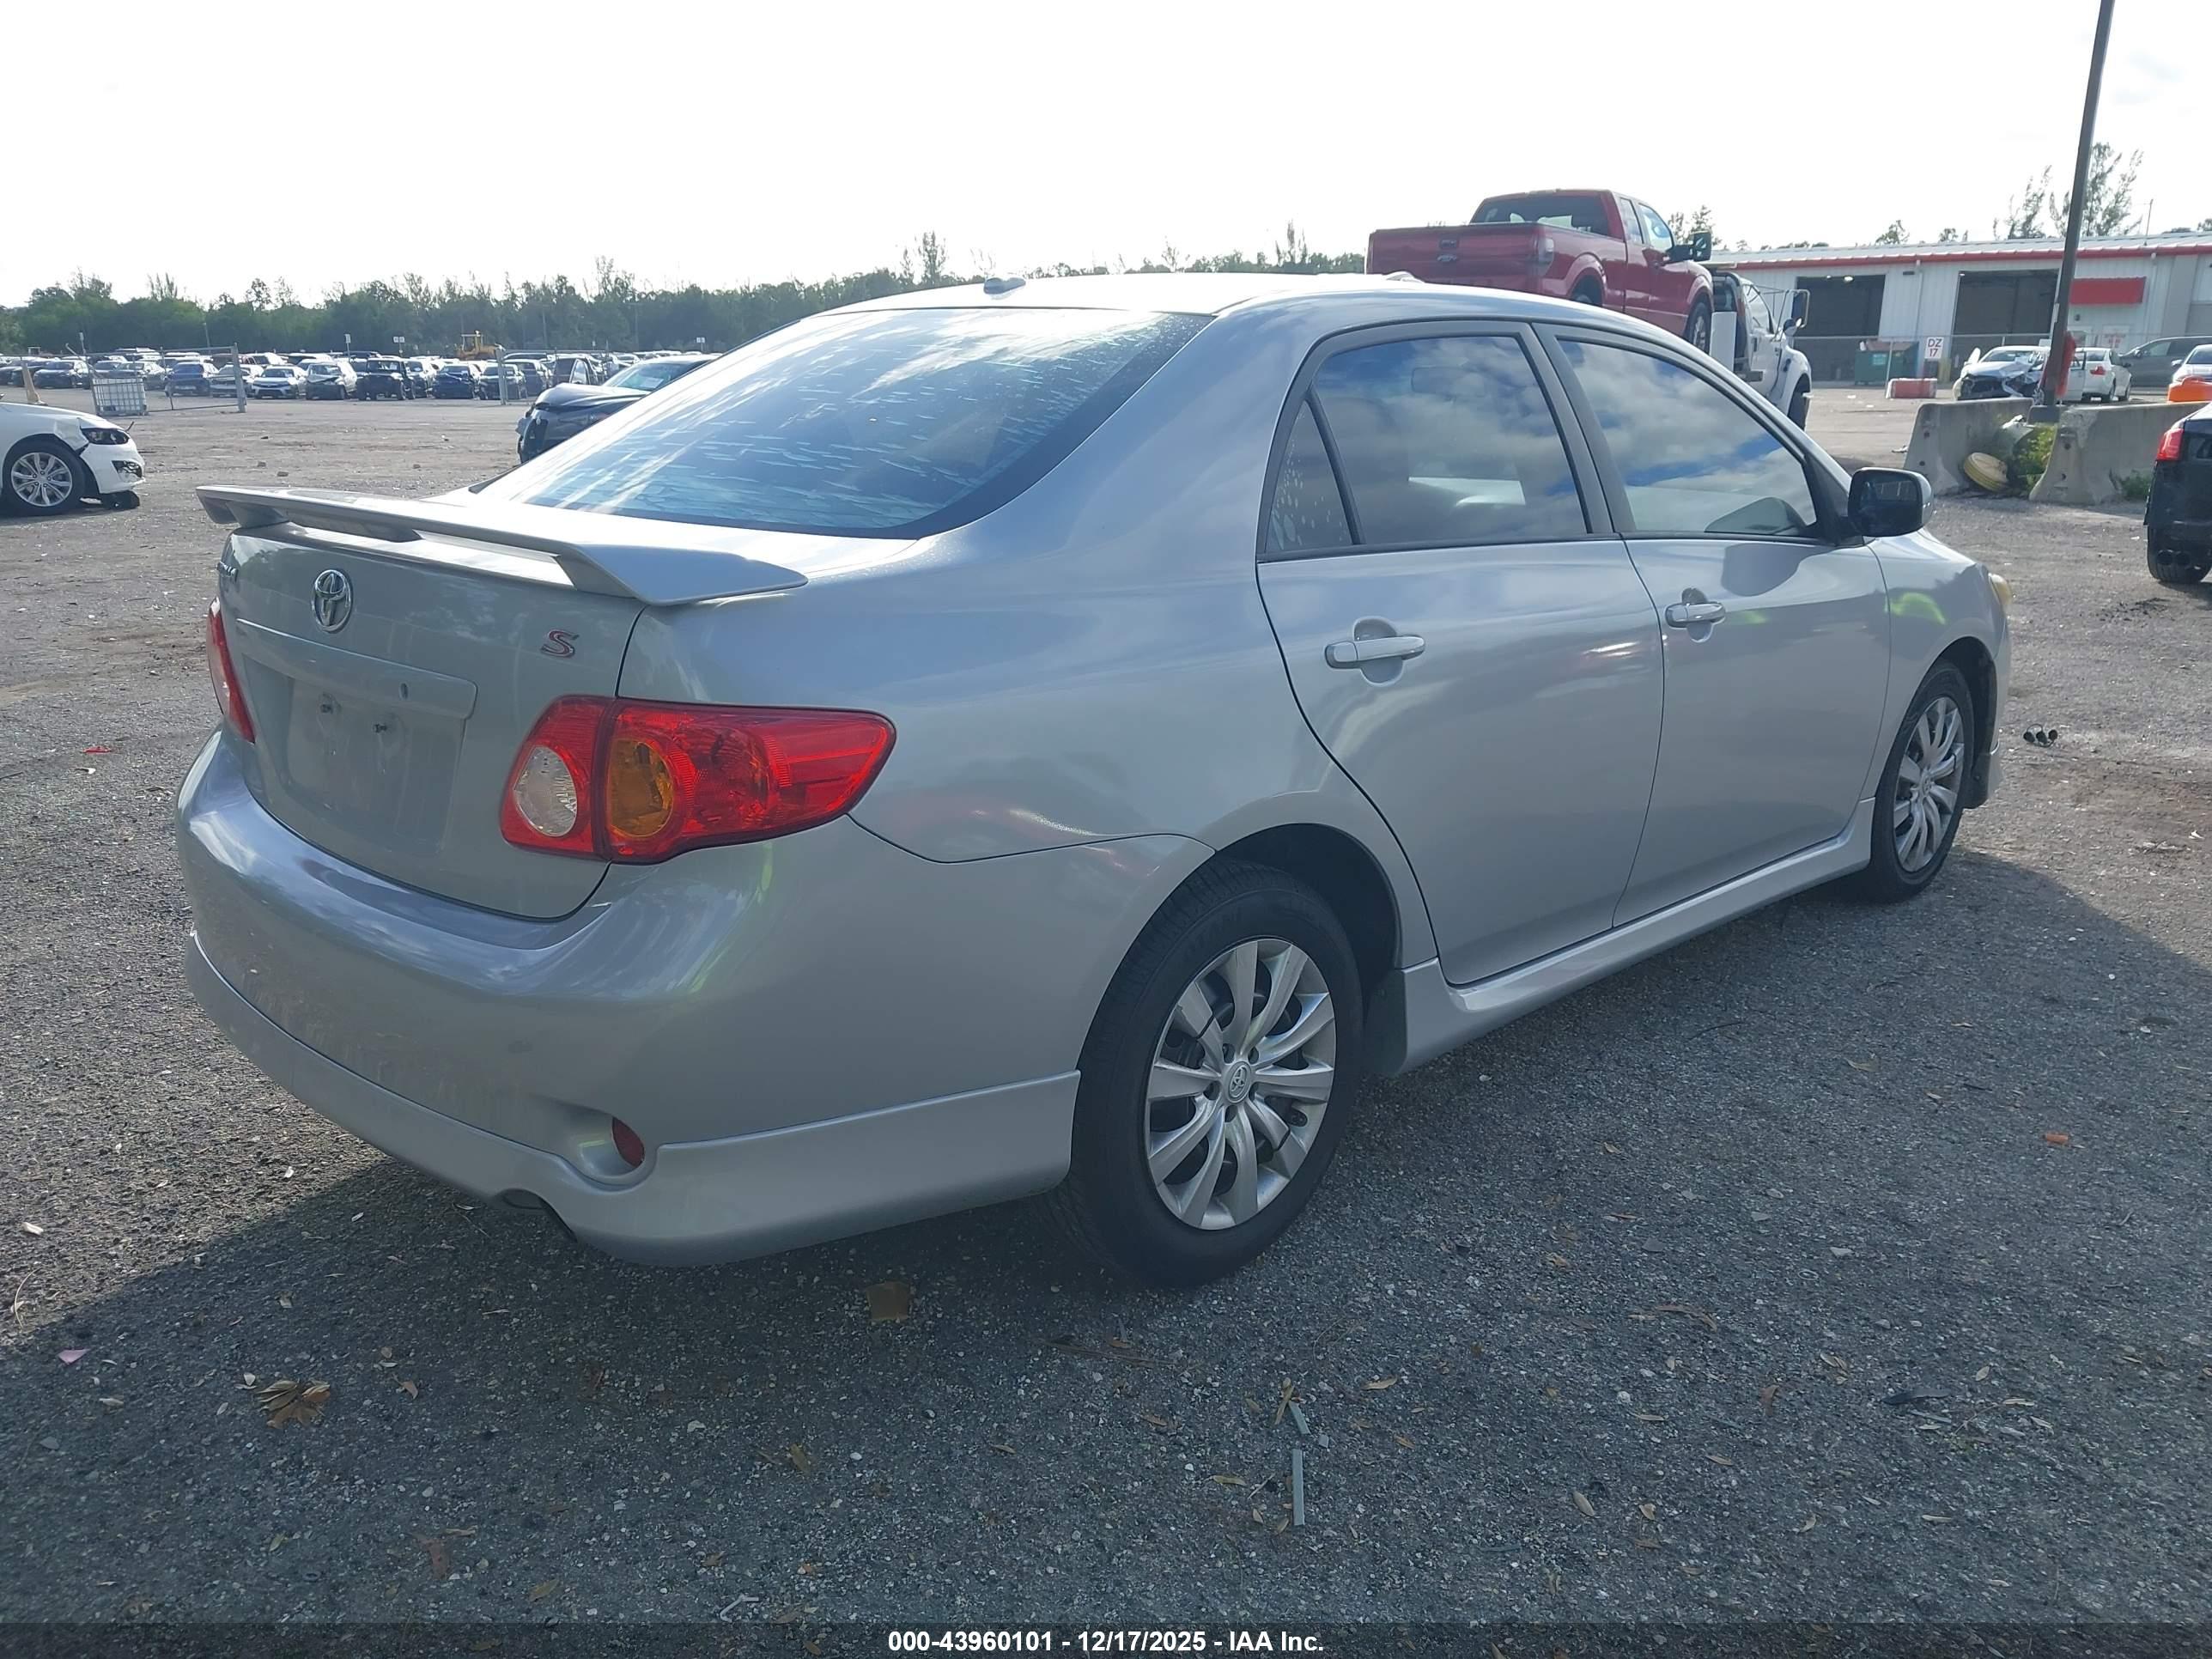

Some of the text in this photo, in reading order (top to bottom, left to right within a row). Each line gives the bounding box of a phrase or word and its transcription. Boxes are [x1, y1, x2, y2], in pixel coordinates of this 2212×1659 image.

[1928, 338, 1942, 348] DZ
[1929, 348, 1938, 357] 17
[541, 629, 580, 658] S
